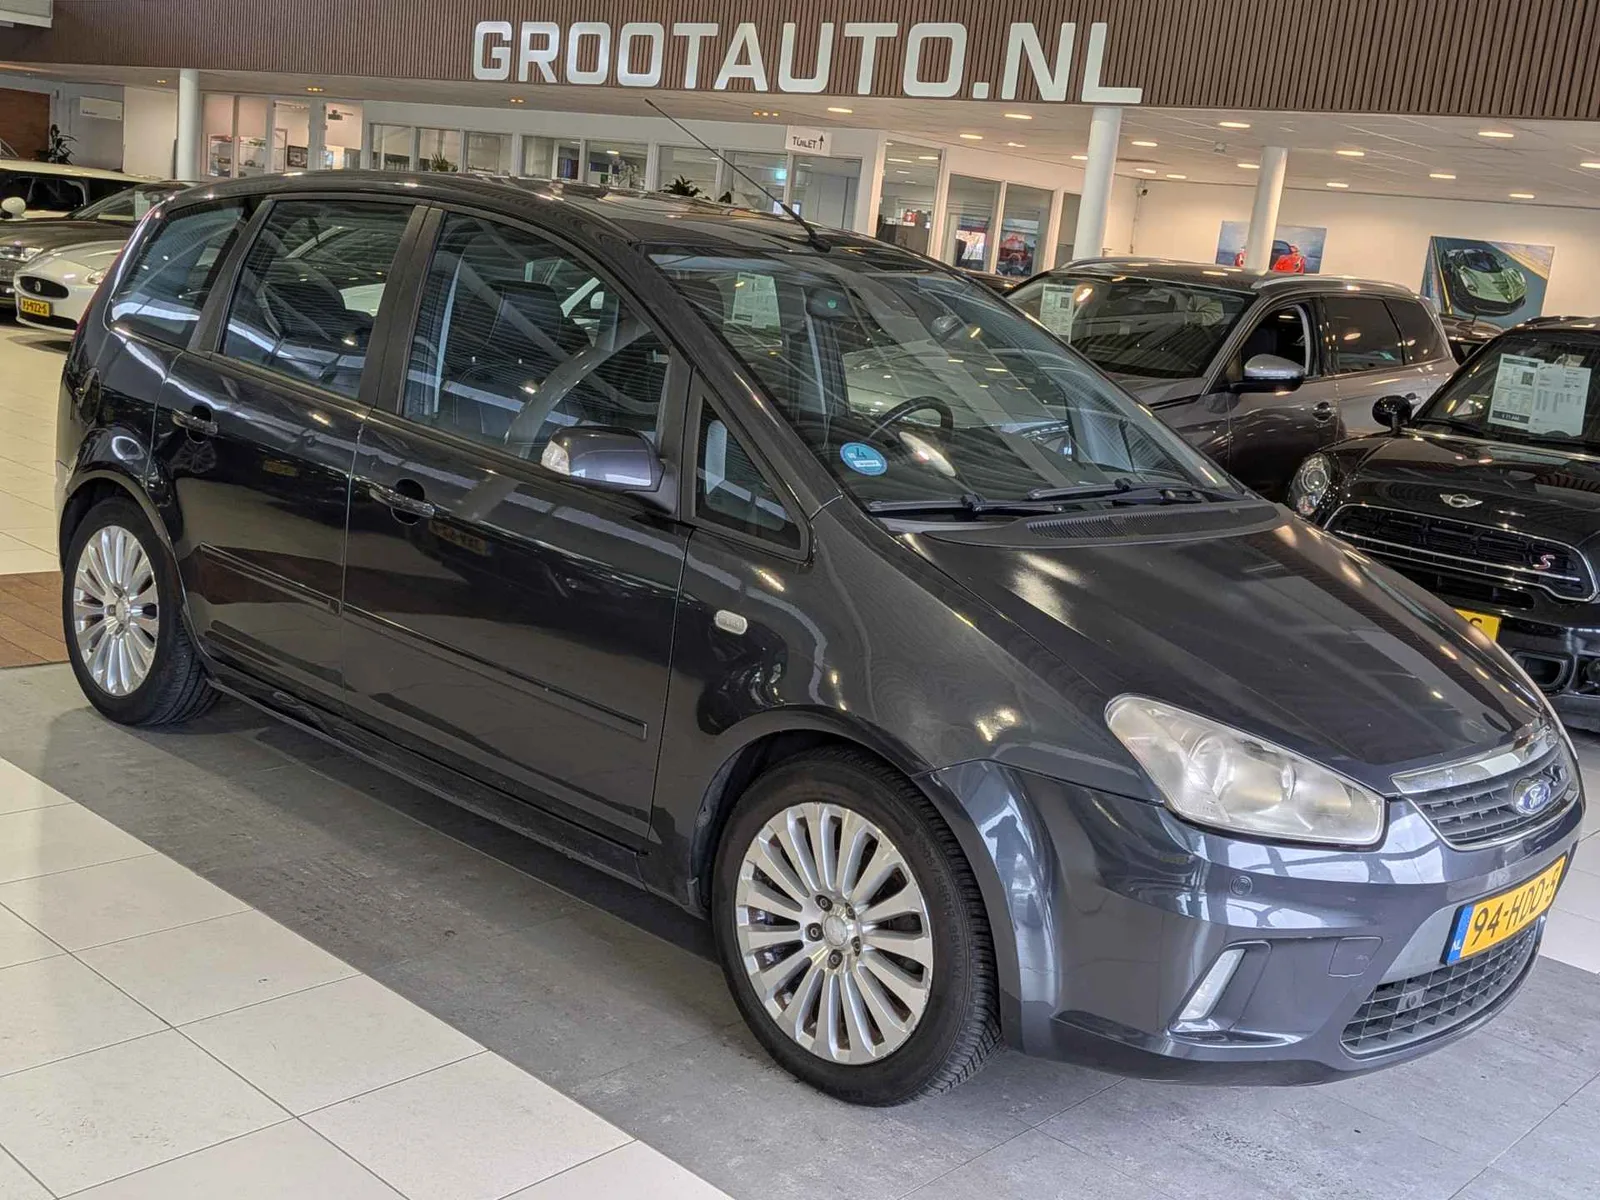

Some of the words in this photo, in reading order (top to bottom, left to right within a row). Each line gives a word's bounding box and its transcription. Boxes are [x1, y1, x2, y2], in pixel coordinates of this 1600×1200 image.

[473, 21, 1143, 104] GROOTAUTO.NL
[1532, 554, 1556, 570] S
[1471, 866, 1560, 946] 94-HDD-5
[1452, 939, 1461, 950] NL
